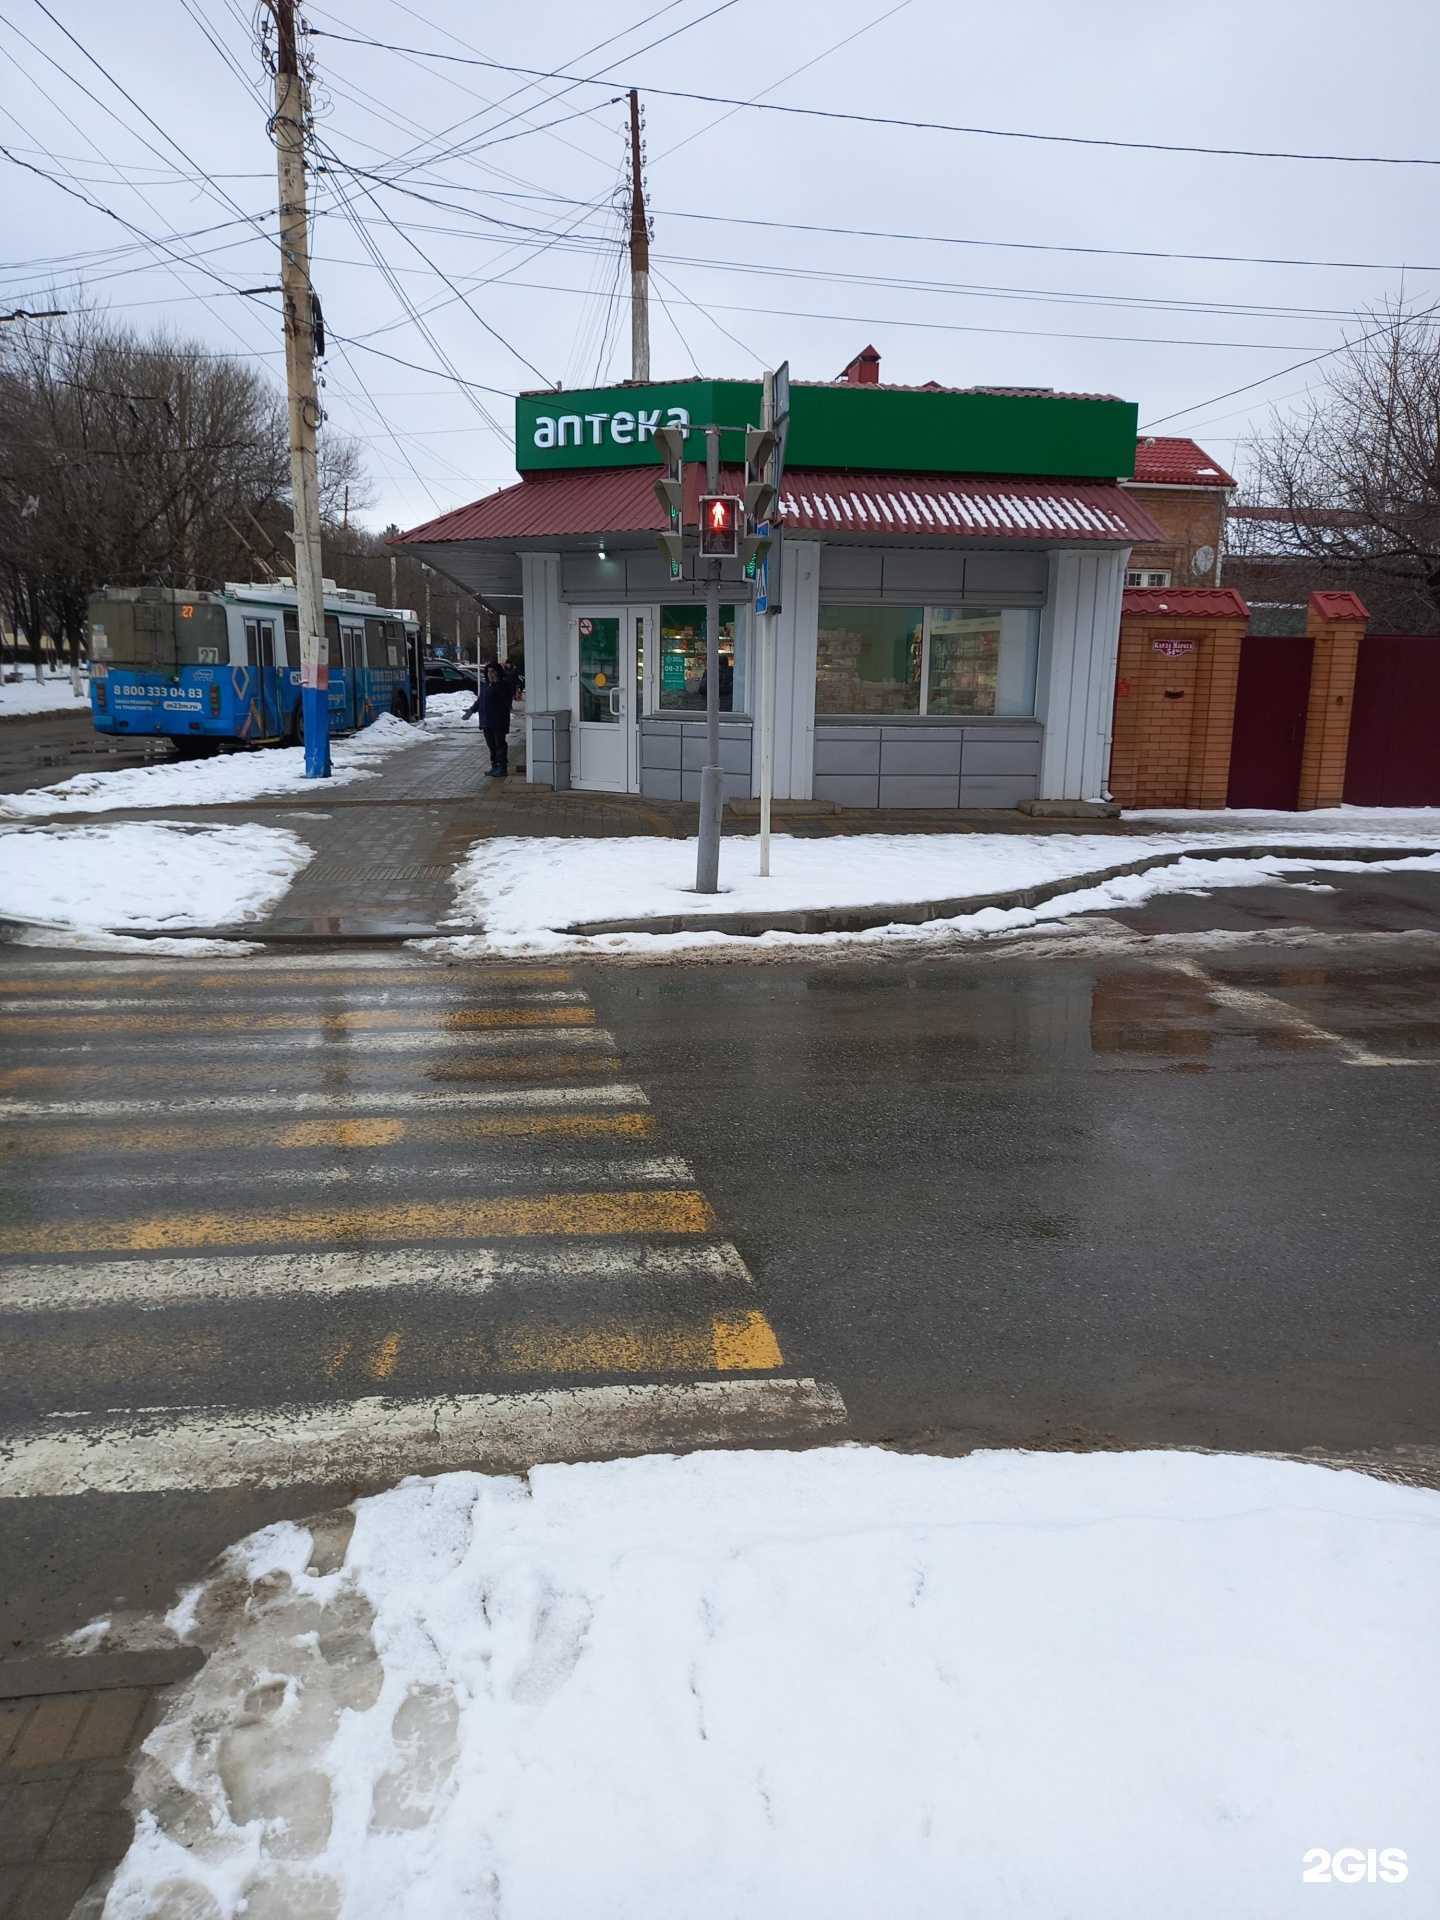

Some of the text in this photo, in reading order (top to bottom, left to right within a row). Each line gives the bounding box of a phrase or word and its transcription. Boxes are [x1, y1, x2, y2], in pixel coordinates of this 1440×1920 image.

[533, 407, 691, 448] аптека
[182, 606, 193, 618] 27
[200, 649, 217, 663] 27
[113, 685, 202, 699] 8 800 333 04 83
